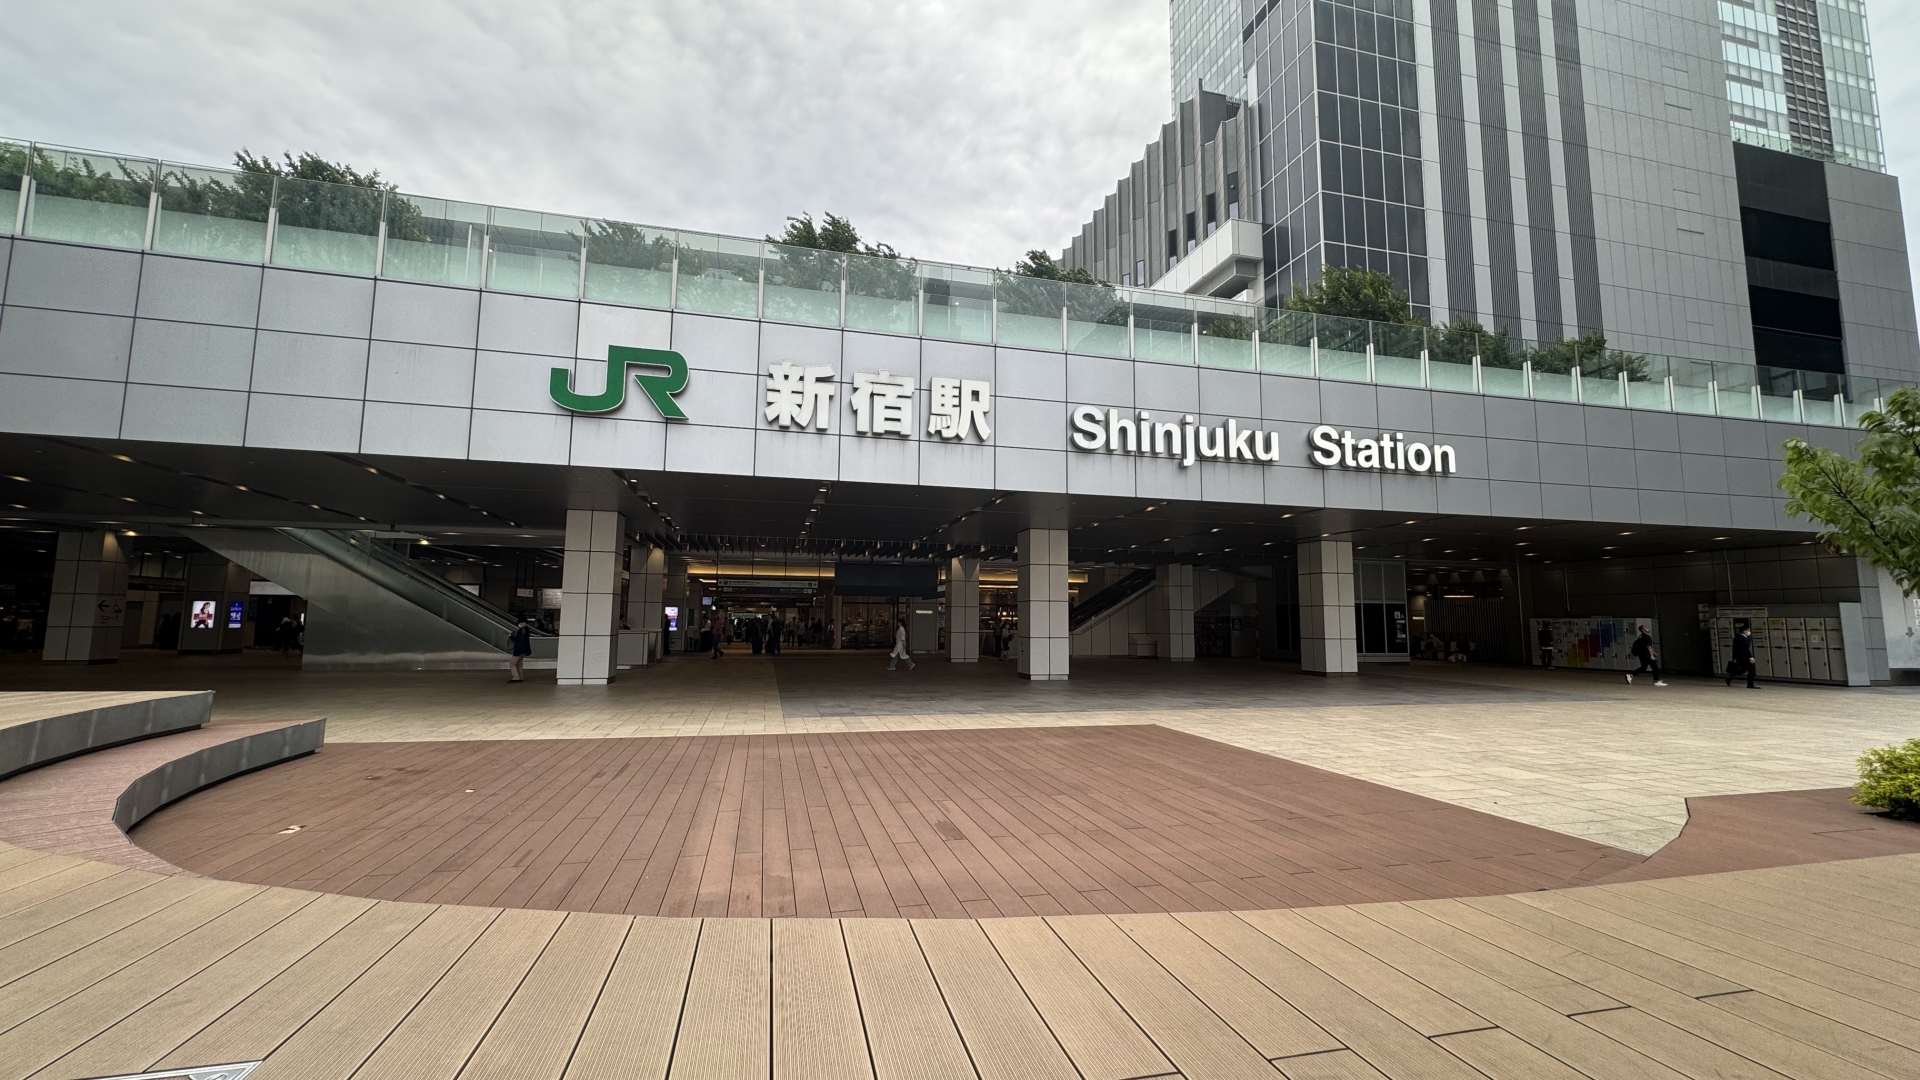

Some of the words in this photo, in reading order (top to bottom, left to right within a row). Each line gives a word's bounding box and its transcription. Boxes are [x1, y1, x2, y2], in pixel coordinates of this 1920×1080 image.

[549, 344, 690, 420] JR
[763, 359, 992, 442] 新宿駅
[1071, 404, 1280, 468] Shinjuku
[1309, 425, 1457, 474] Station
